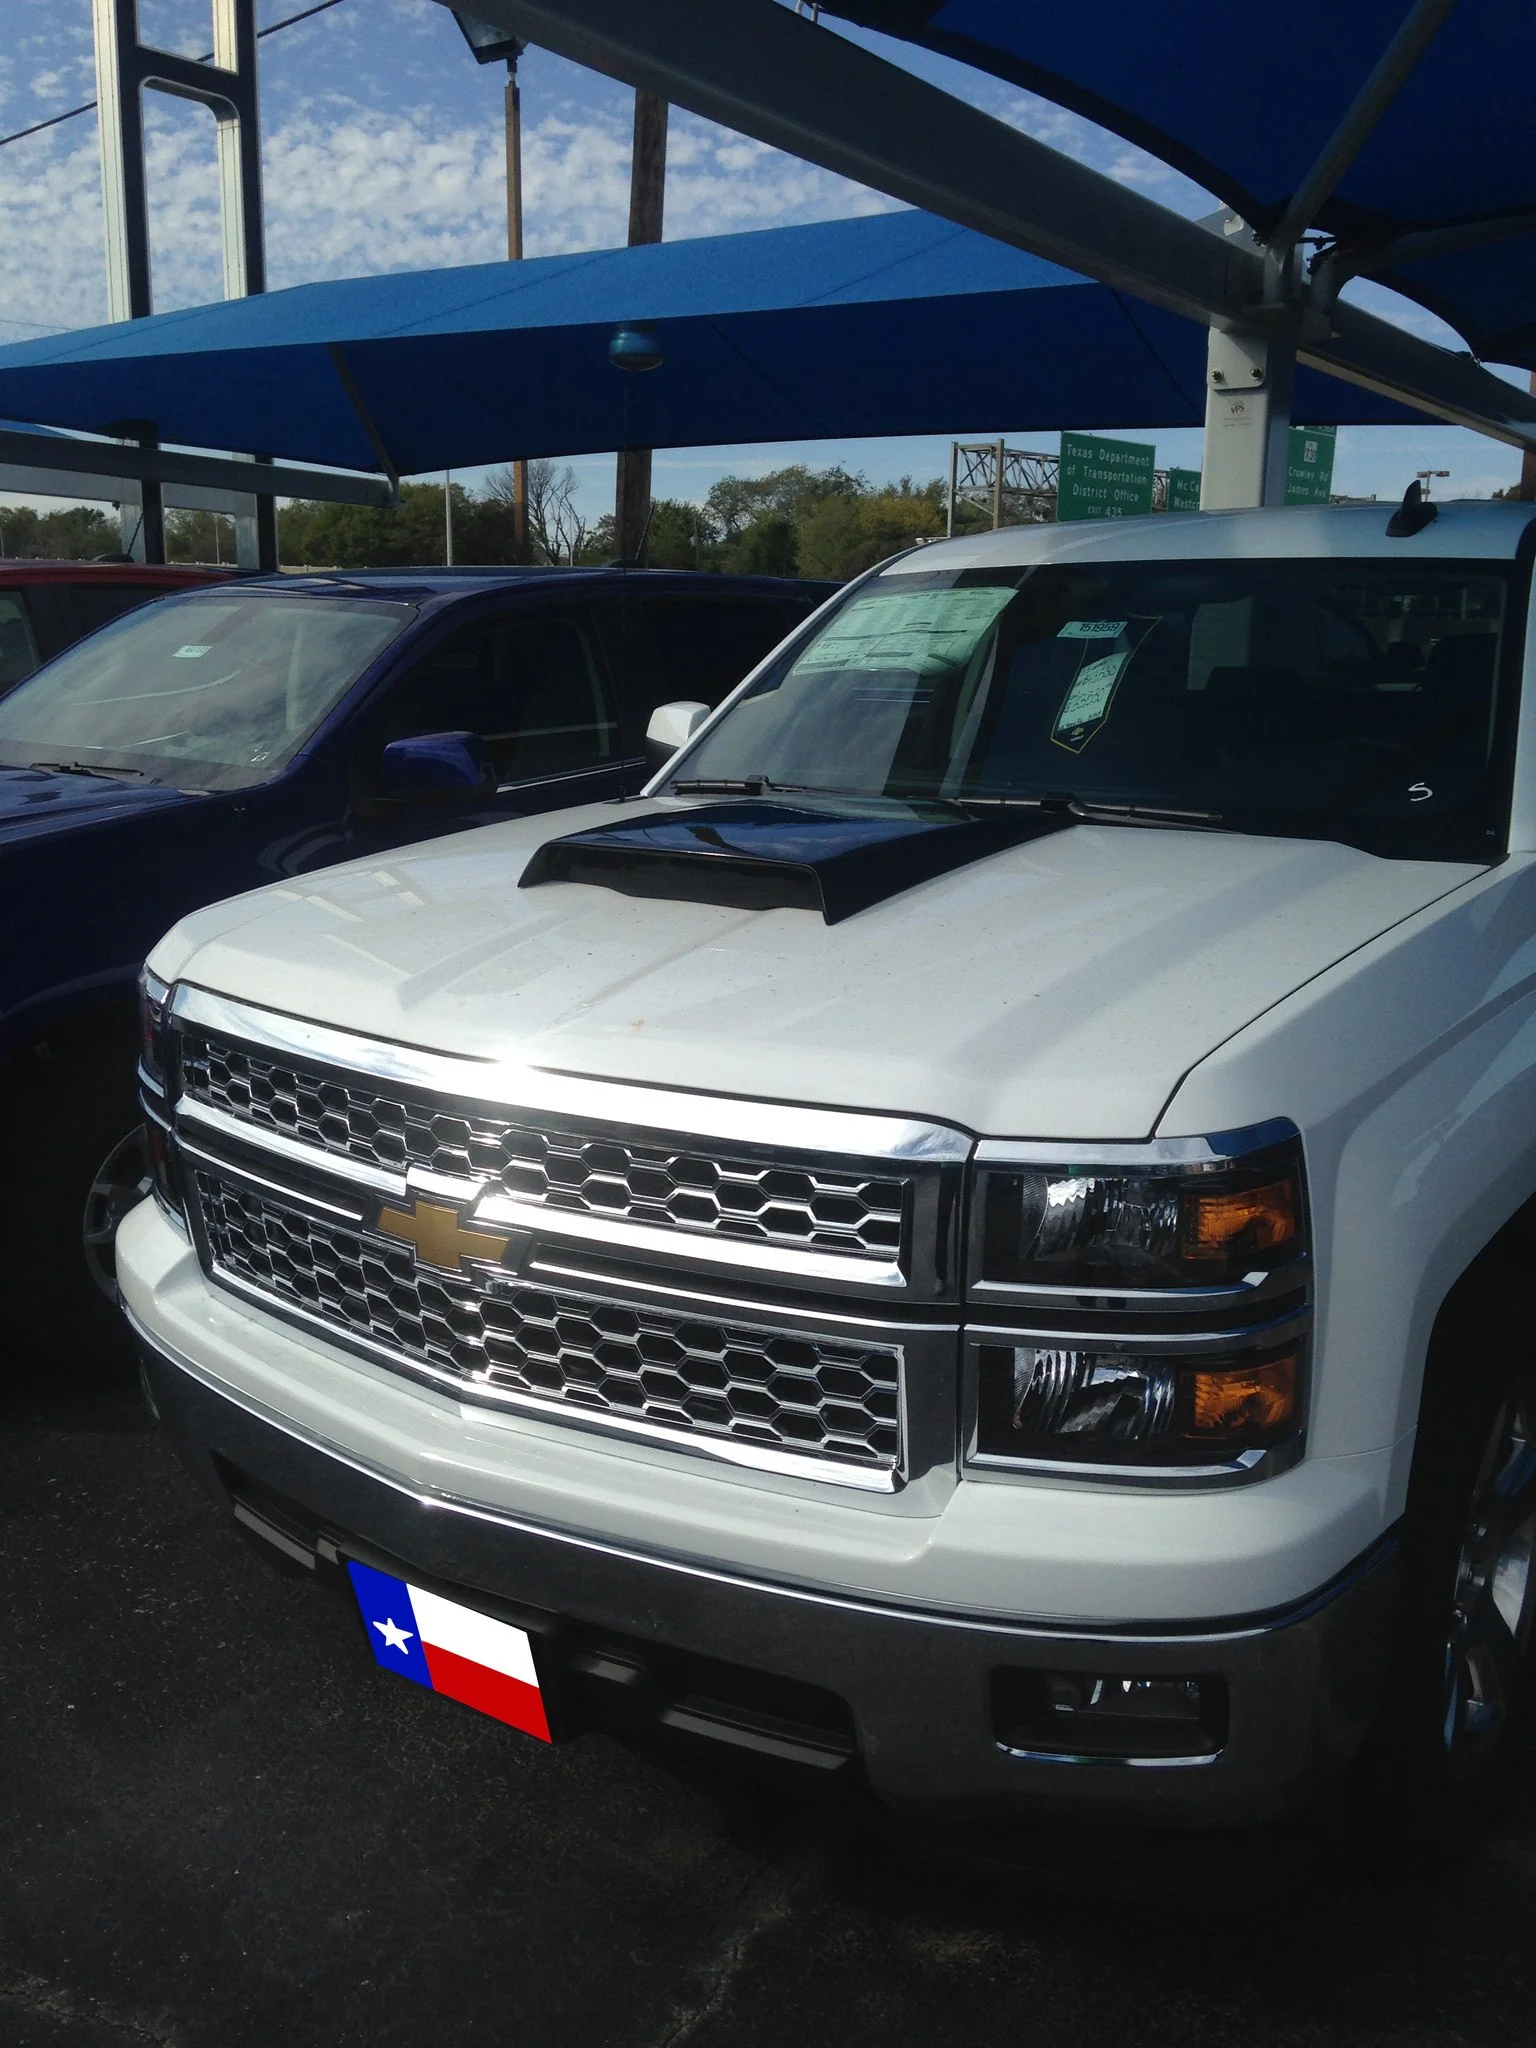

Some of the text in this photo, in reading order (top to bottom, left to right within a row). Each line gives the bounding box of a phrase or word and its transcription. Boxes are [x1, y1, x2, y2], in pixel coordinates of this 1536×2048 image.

[1067, 444, 1150, 467] Texas Department
[1066, 464, 1147, 485] of Transportation
[1288, 466, 1329, 482] Crowley Rd
[1072, 483, 1140, 502] District Office
[1287, 483, 1309, 496] James
[1087, 505, 1123, 518] EXIT 435
[1079, 622, 1120, 633] 151959
